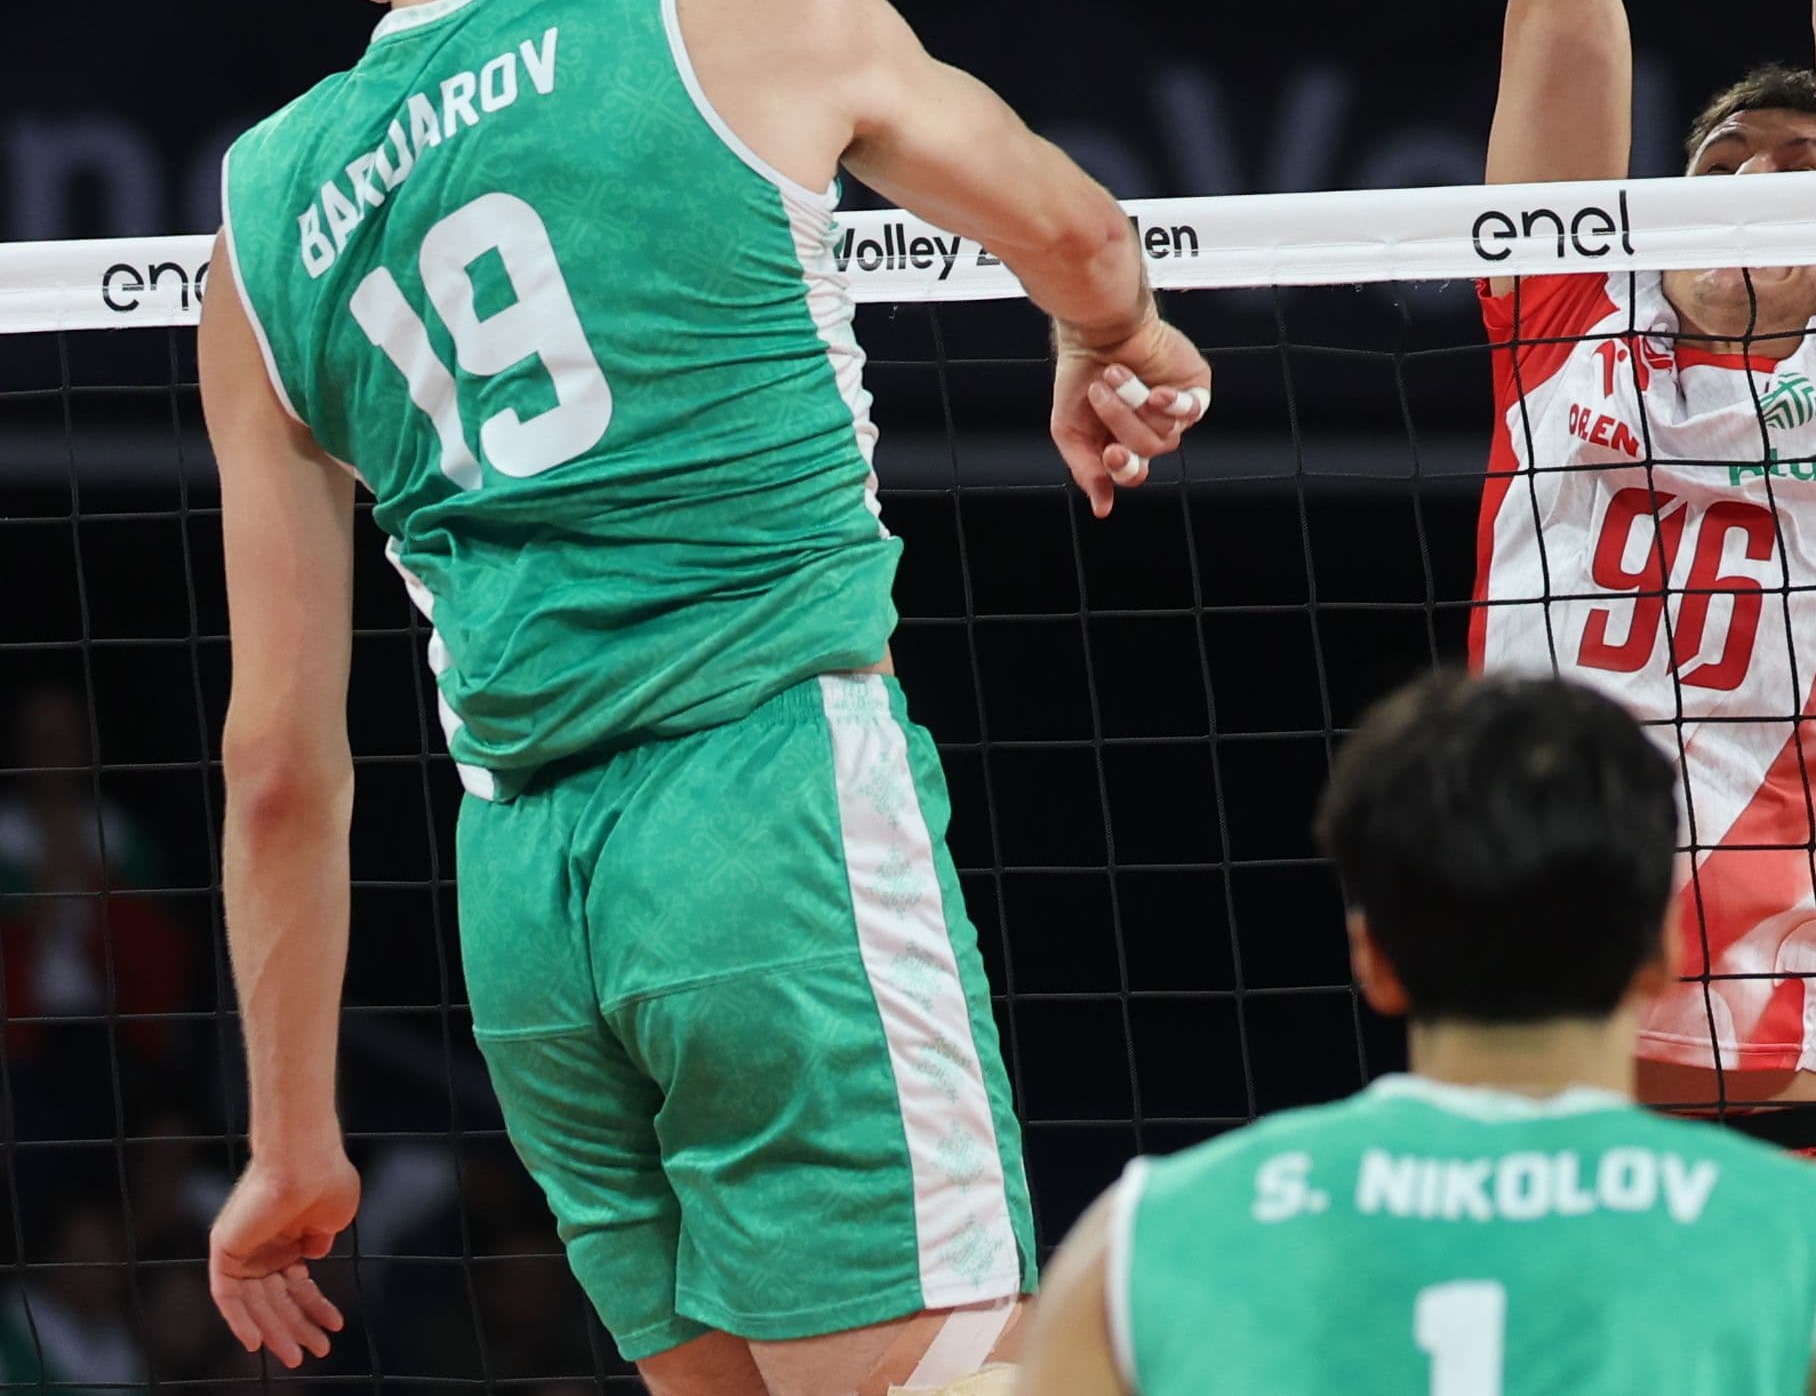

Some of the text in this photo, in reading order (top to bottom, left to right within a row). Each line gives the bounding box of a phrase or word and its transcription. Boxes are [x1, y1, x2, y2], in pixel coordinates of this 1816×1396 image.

[836, 216, 1199, 281] Volley en
[1472, 189, 1634, 261] enel
[102, 262, 208, 313] en
[349, 192, 613, 490] 19
[1577, 486, 1776, 692] 96
[1253, 1147, 1719, 1223] S. NIKOLOV
[1414, 1280, 1506, 1396] 1
